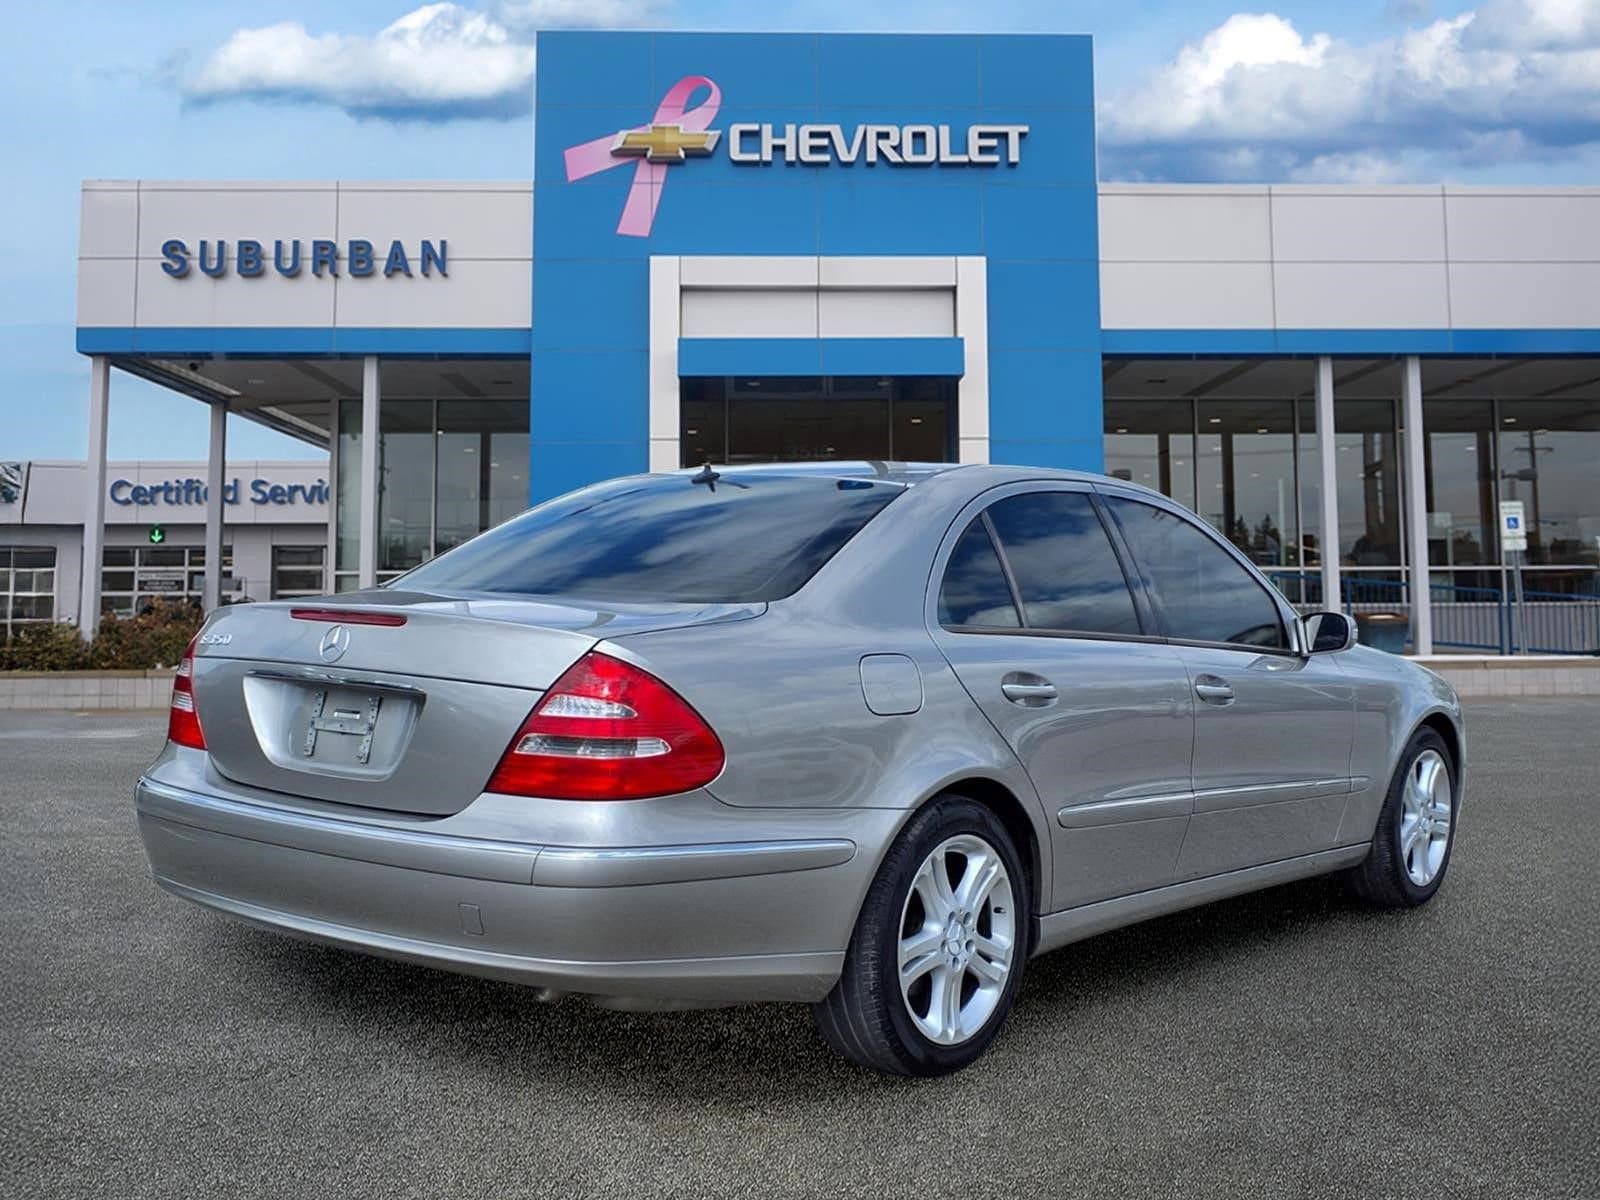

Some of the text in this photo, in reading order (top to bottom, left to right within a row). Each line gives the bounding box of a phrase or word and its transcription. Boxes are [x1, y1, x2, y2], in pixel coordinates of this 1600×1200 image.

[729, 123, 1030, 166] CHEVROLET
[160, 239, 449, 279] SUBURBAN
[110, 478, 240, 506] Certifid
